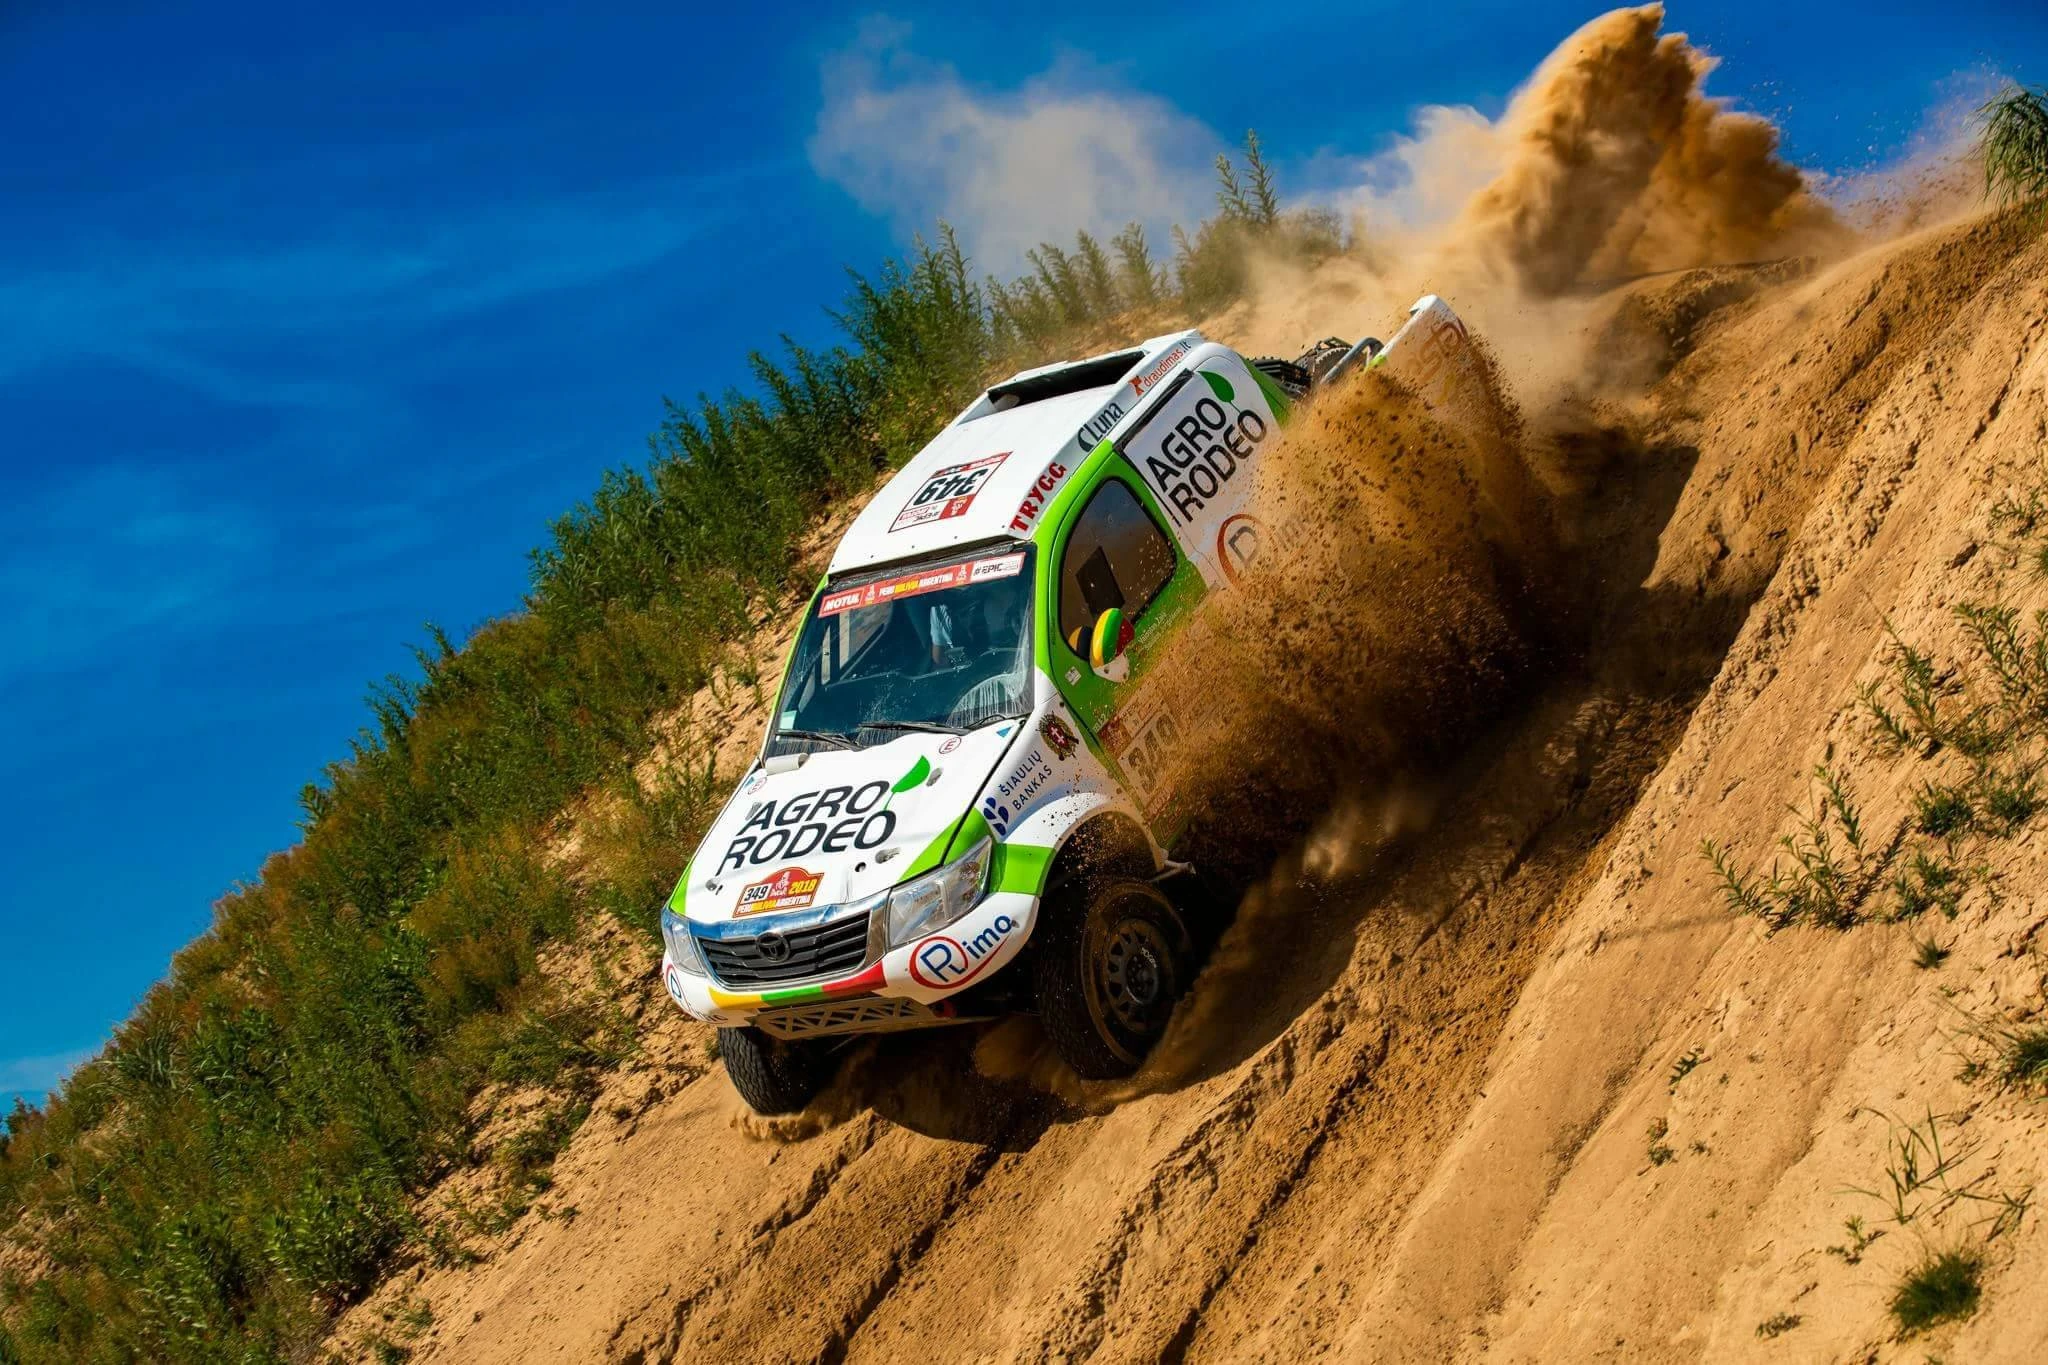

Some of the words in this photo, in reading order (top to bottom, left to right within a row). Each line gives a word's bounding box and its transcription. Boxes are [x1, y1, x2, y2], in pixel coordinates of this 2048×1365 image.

[1143, 341, 1192, 387] draudimas.lt
[1146, 397, 1227, 492] AGRO
[1167, 409, 1267, 523] RODEO
[913, 468, 989, 505] 349
[1010, 462, 1068, 532] TRYGG
[824, 593, 860, 611] MOTUL
[998, 750, 1043, 797] ŠIAULIŲ
[1012, 764, 1053, 810] BANKAS
[736, 780, 890, 836] AGRO
[716, 810, 896, 876] RODEO
[744, 885, 769, 901] 349
[788, 879, 817, 895] 2018
